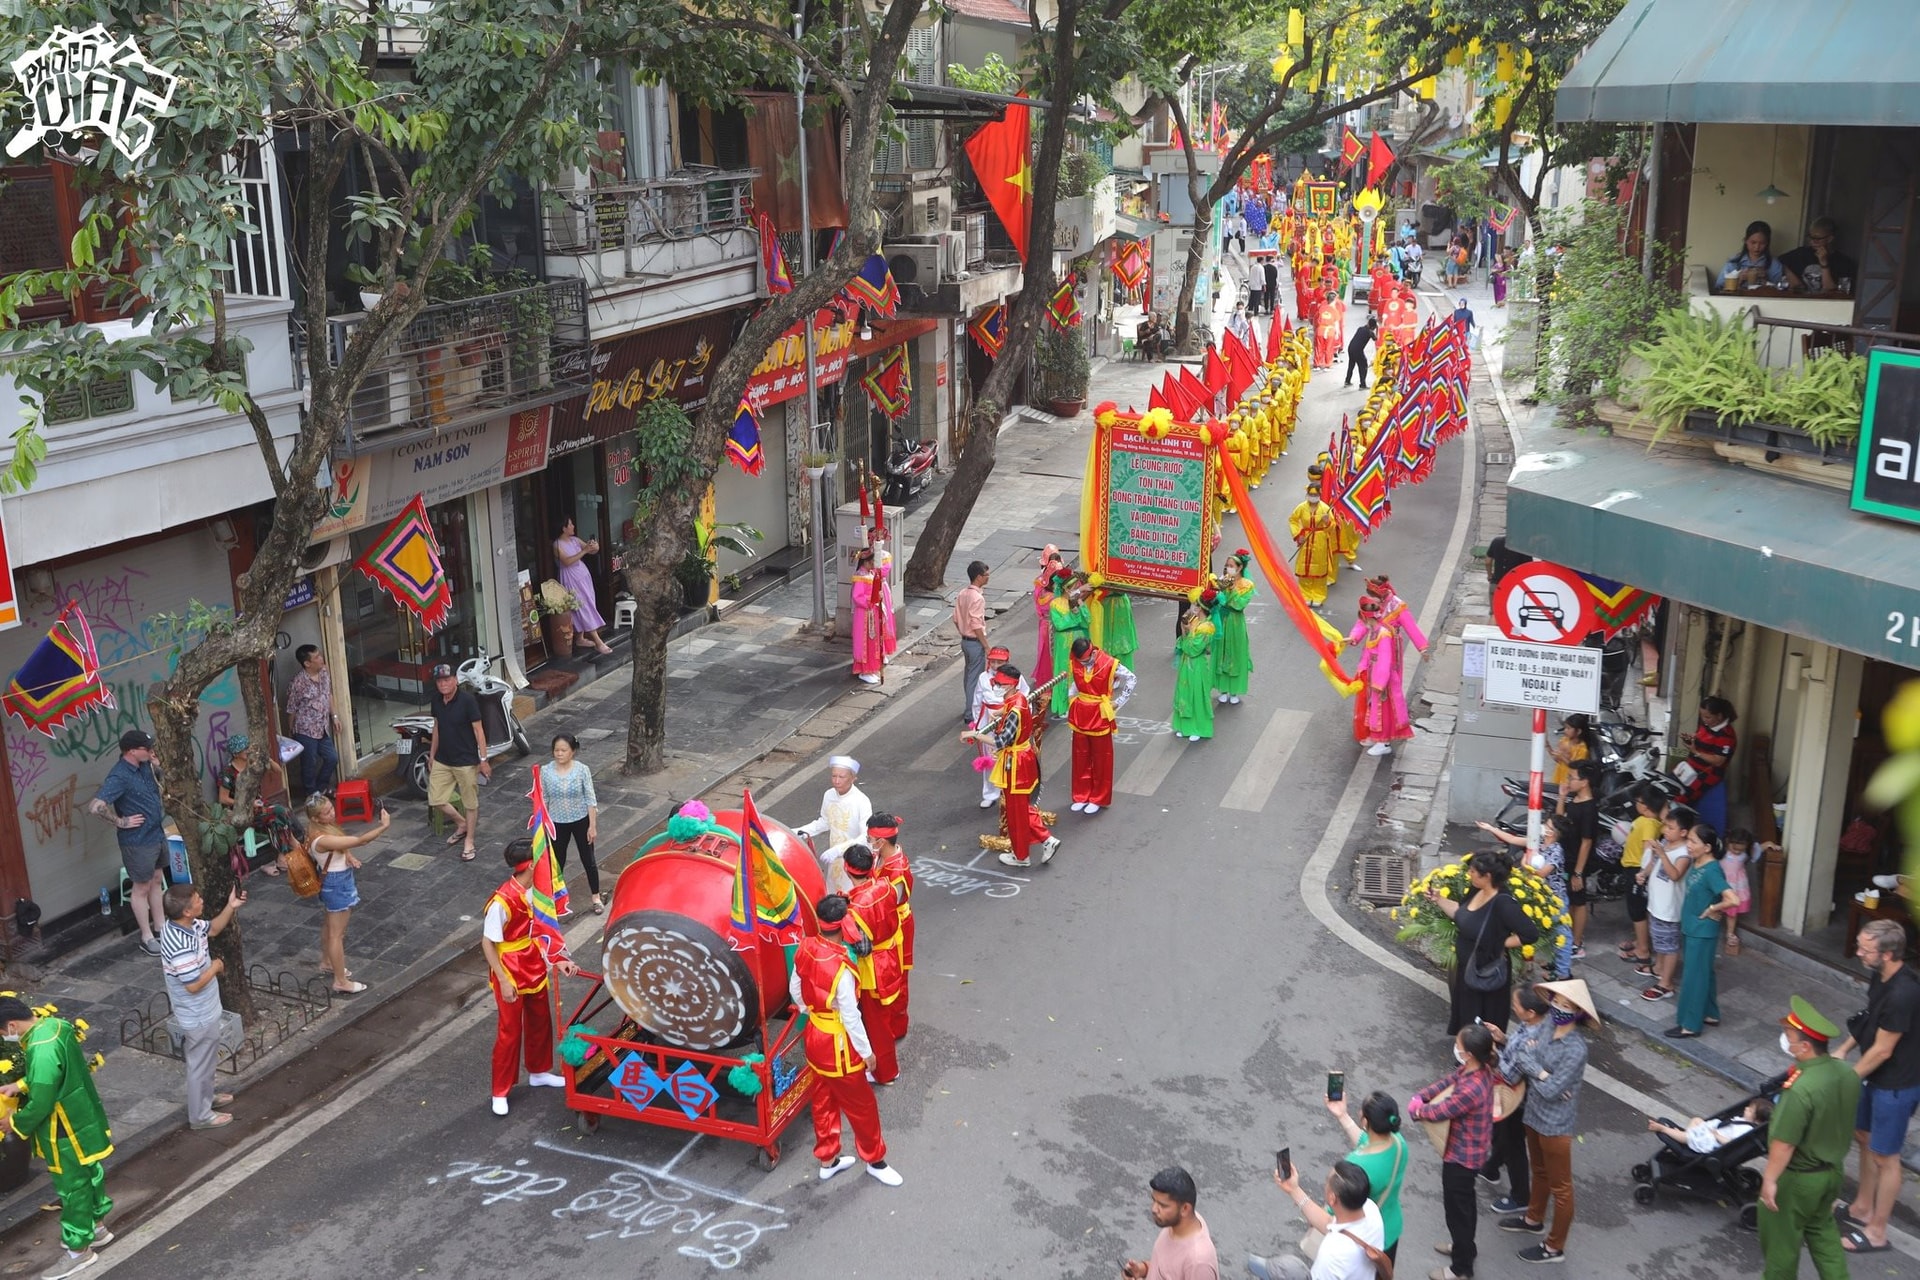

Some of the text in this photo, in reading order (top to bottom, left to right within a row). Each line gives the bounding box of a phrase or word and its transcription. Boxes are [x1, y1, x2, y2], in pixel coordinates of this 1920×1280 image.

[583, 378, 621, 421] Phở
[620, 368, 645, 410] Gà
[670, 359, 687, 391] 7
[436, 430, 454, 447] TY
[454, 422, 488, 442] TNHH
[1123, 433, 1145, 444] BẠCH
[1161, 439, 1179, 447] LINH
[507, 443, 544, 463] ESPIRITU
[413, 451, 443, 474] NAM
[510, 455, 539, 472] DE CHILE
[1180, 500, 1200, 512] LONG
[1152, 531, 1160, 542] DI
[1141, 547, 1153, 558] GIA
[1886, 611, 1905, 643] 2
[1490, 645, 1499, 655] XE
[1521, 678, 1561, 694] NGOẠI LỆ
[1523, 691, 1559, 704] Except
[613, 1061, 713, 1114] 馬 白
